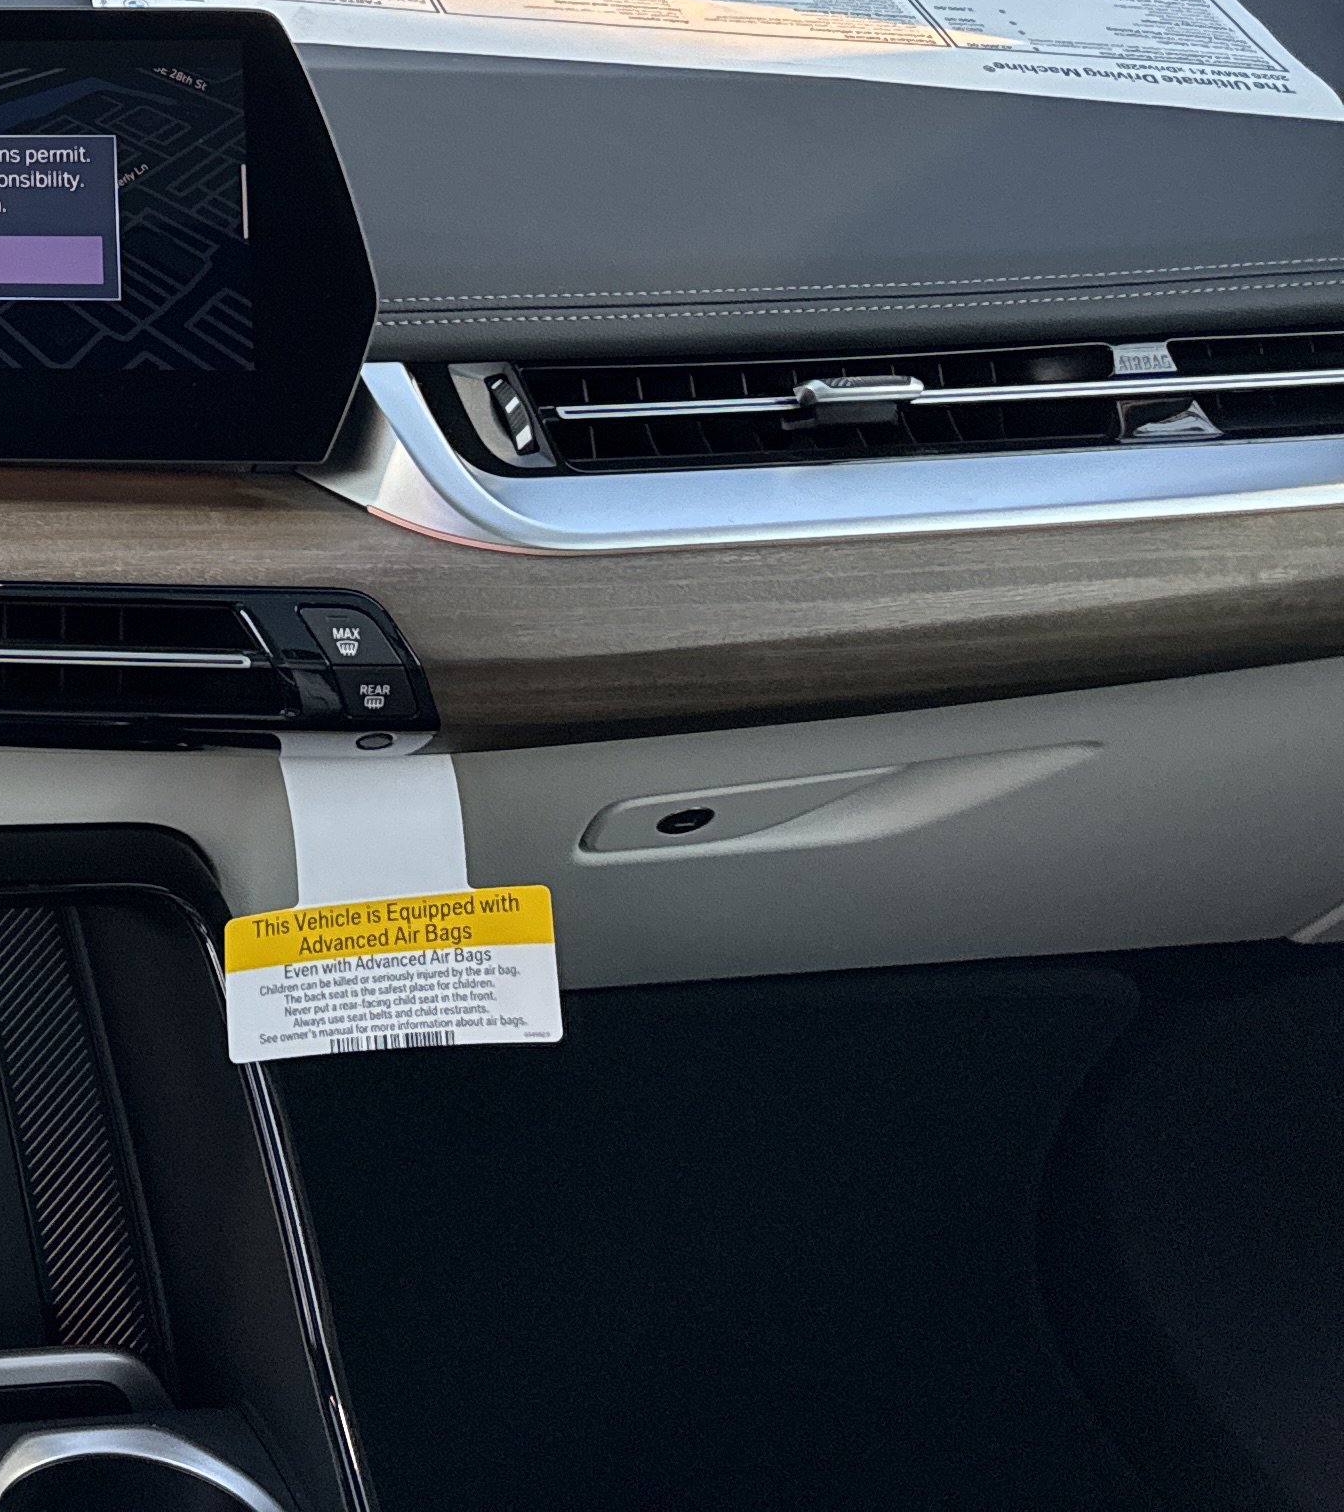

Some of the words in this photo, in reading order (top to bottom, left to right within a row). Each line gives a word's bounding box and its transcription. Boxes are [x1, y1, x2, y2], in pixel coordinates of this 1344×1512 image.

[169, 69, 192, 85] 28th
[194, 79, 208, 91] St
[1083, 67, 1159, 84] Driving
[1161, 75, 1250, 90] Ultimate
[1252, 82, 1297, 94] The
[25, 146, 91, 166] permit.
[134, 163, 149, 175] Ln
[1119, 353, 1171, 371] AIRBAG
[332, 627, 361, 639] MAX
[359, 684, 390, 695] REAR
[252, 916, 290, 938] This
[294, 908, 361, 931] Vehicle
[367, 905, 381, 924] is
[386, 896, 475, 924] Equipped
[480, 893, 520, 913] with
[299, 928, 389, 955] Advanced
[394, 925, 420, 945] Air
[425, 923, 472, 945] Bags
[284, 963, 318, 979] Even
[322, 958, 352, 975] with
[355, 949, 427, 971] Advanced
[430, 948, 450, 965] Air
[454, 948, 492, 965] Bags
[259, 984, 299, 996] Children
[301, 981, 317, 991] can
[319, 978, 331, 989] be
[333, 976, 358, 987] killed
[360, 976, 369, 984] or
[372, 969, 414, 982] seriously
[416, 967, 449, 981] injured
[451, 967, 462, 978] by
[465, 966, 481, 977] the
[484, 966, 495, 976] air
[498, 964, 520, 978] bag.
[284, 994, 302, 1005] The
[304, 991, 327, 1002] back
[328, 989, 349, 1000] seat
[350, 988, 359, 998] is
[361, 986, 376, 996] the
[378, 984, 407, 994] safest
[409, 982, 435, 994] place
[437, 980, 450, 991] for
[452, 979, 495, 990] children.
[284, 1006, 311, 1017] Never
[314, 1003, 330, 1015] put
[331, 1004, 337, 1012] a
[339, 998, 391, 1011] rear-facing
[393, 994, 416, 1006] child
[418, 993, 439, 1004] seat
[441, 993, 450, 1002] in
[452, 992, 468, 1002] the
[470, 991, 496, 1001] front.
[293, 1016, 326, 1029] Always
[328, 1016, 345, 1025] use
[347, 1012, 368, 1023] seat
[369, 1009, 393, 1020] belts
[395, 1008, 412, 1018] and
[414, 1006, 437, 1017] child
[439, 1003, 490, 1015] restraints.
[259, 1033, 278, 1045] See
[280, 1029, 317, 1041] owner's
[319, 1024, 354, 1038] manual
[356, 1024, 368, 1034] for
[371, 1022, 395, 1033] more
[398, 1019, 453, 1031] information
[455, 1016, 484, 1027] about
[486, 1016, 498, 1026] air
[500, 1015, 528, 1029] bags.
